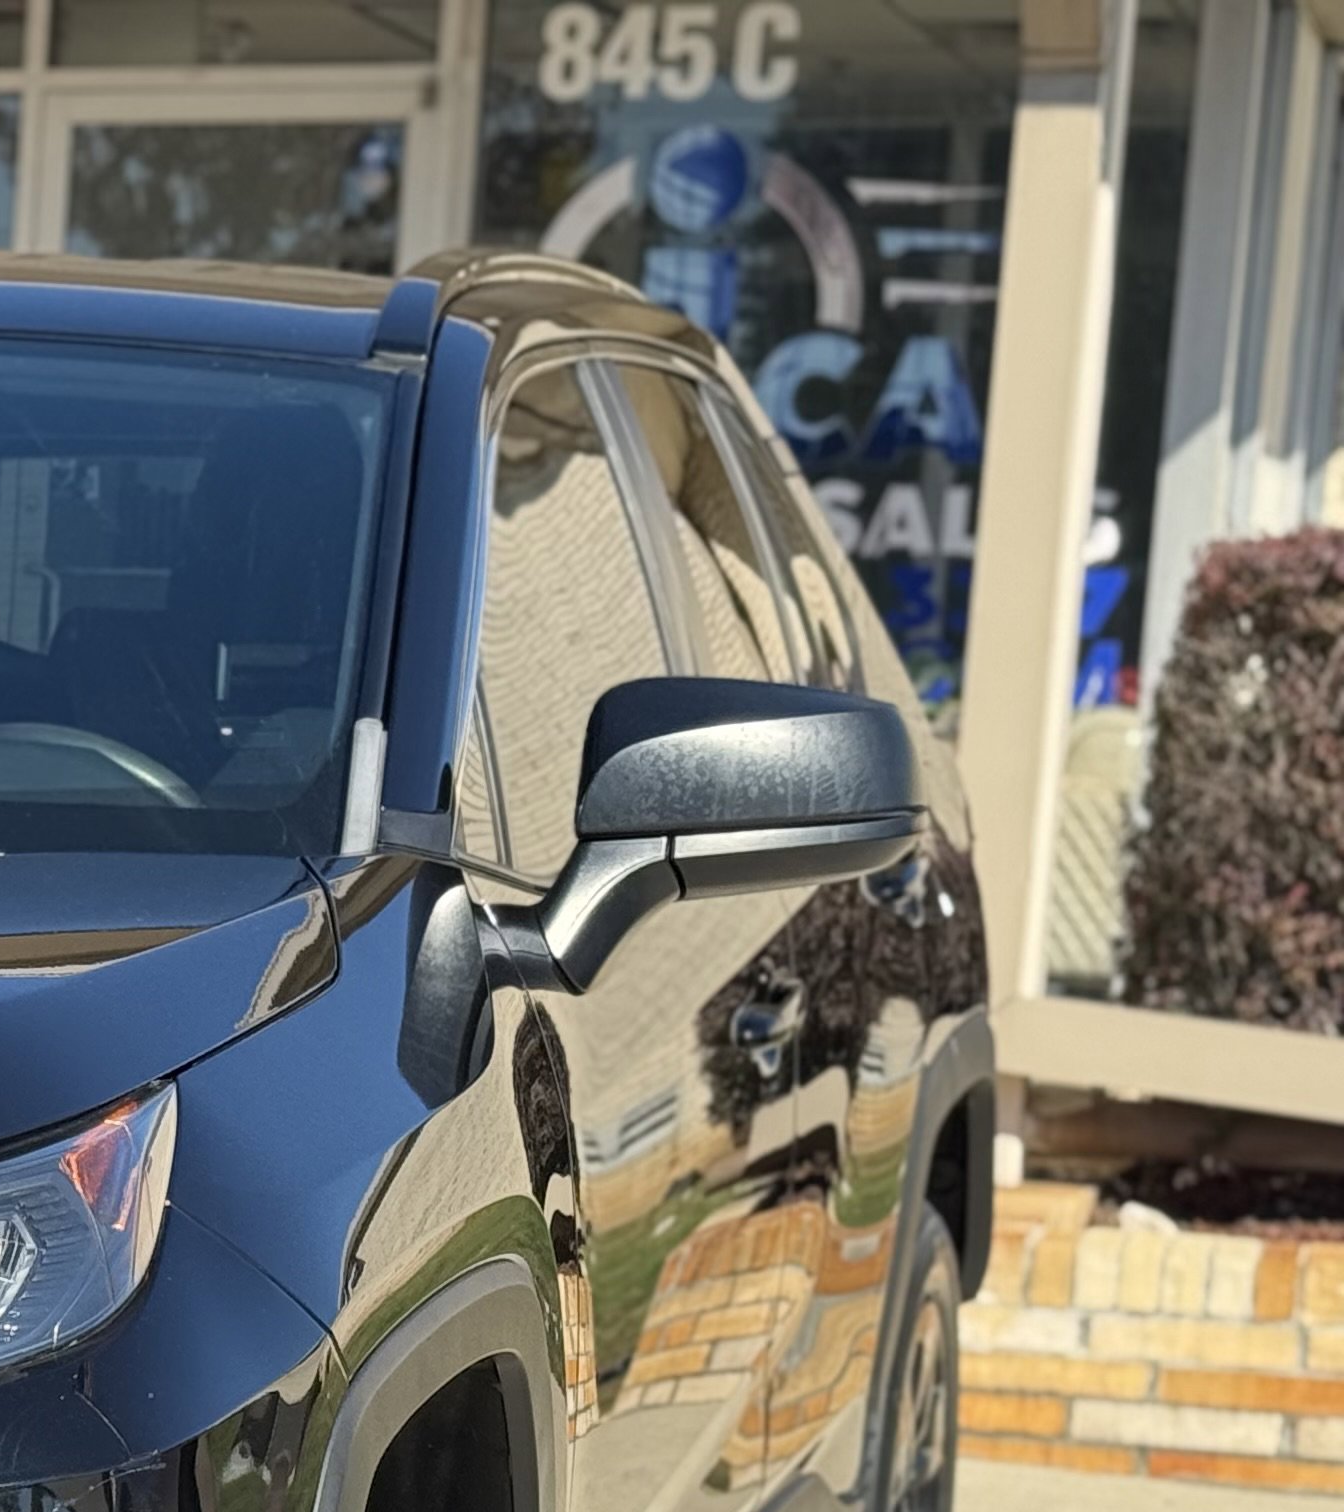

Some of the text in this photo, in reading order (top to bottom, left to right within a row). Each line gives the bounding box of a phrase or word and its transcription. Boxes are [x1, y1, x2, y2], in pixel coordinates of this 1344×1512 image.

[538, 3, 801, 101] 845 C
[754, 333, 986, 464] CA
[809, 478, 1123, 565] SALS
